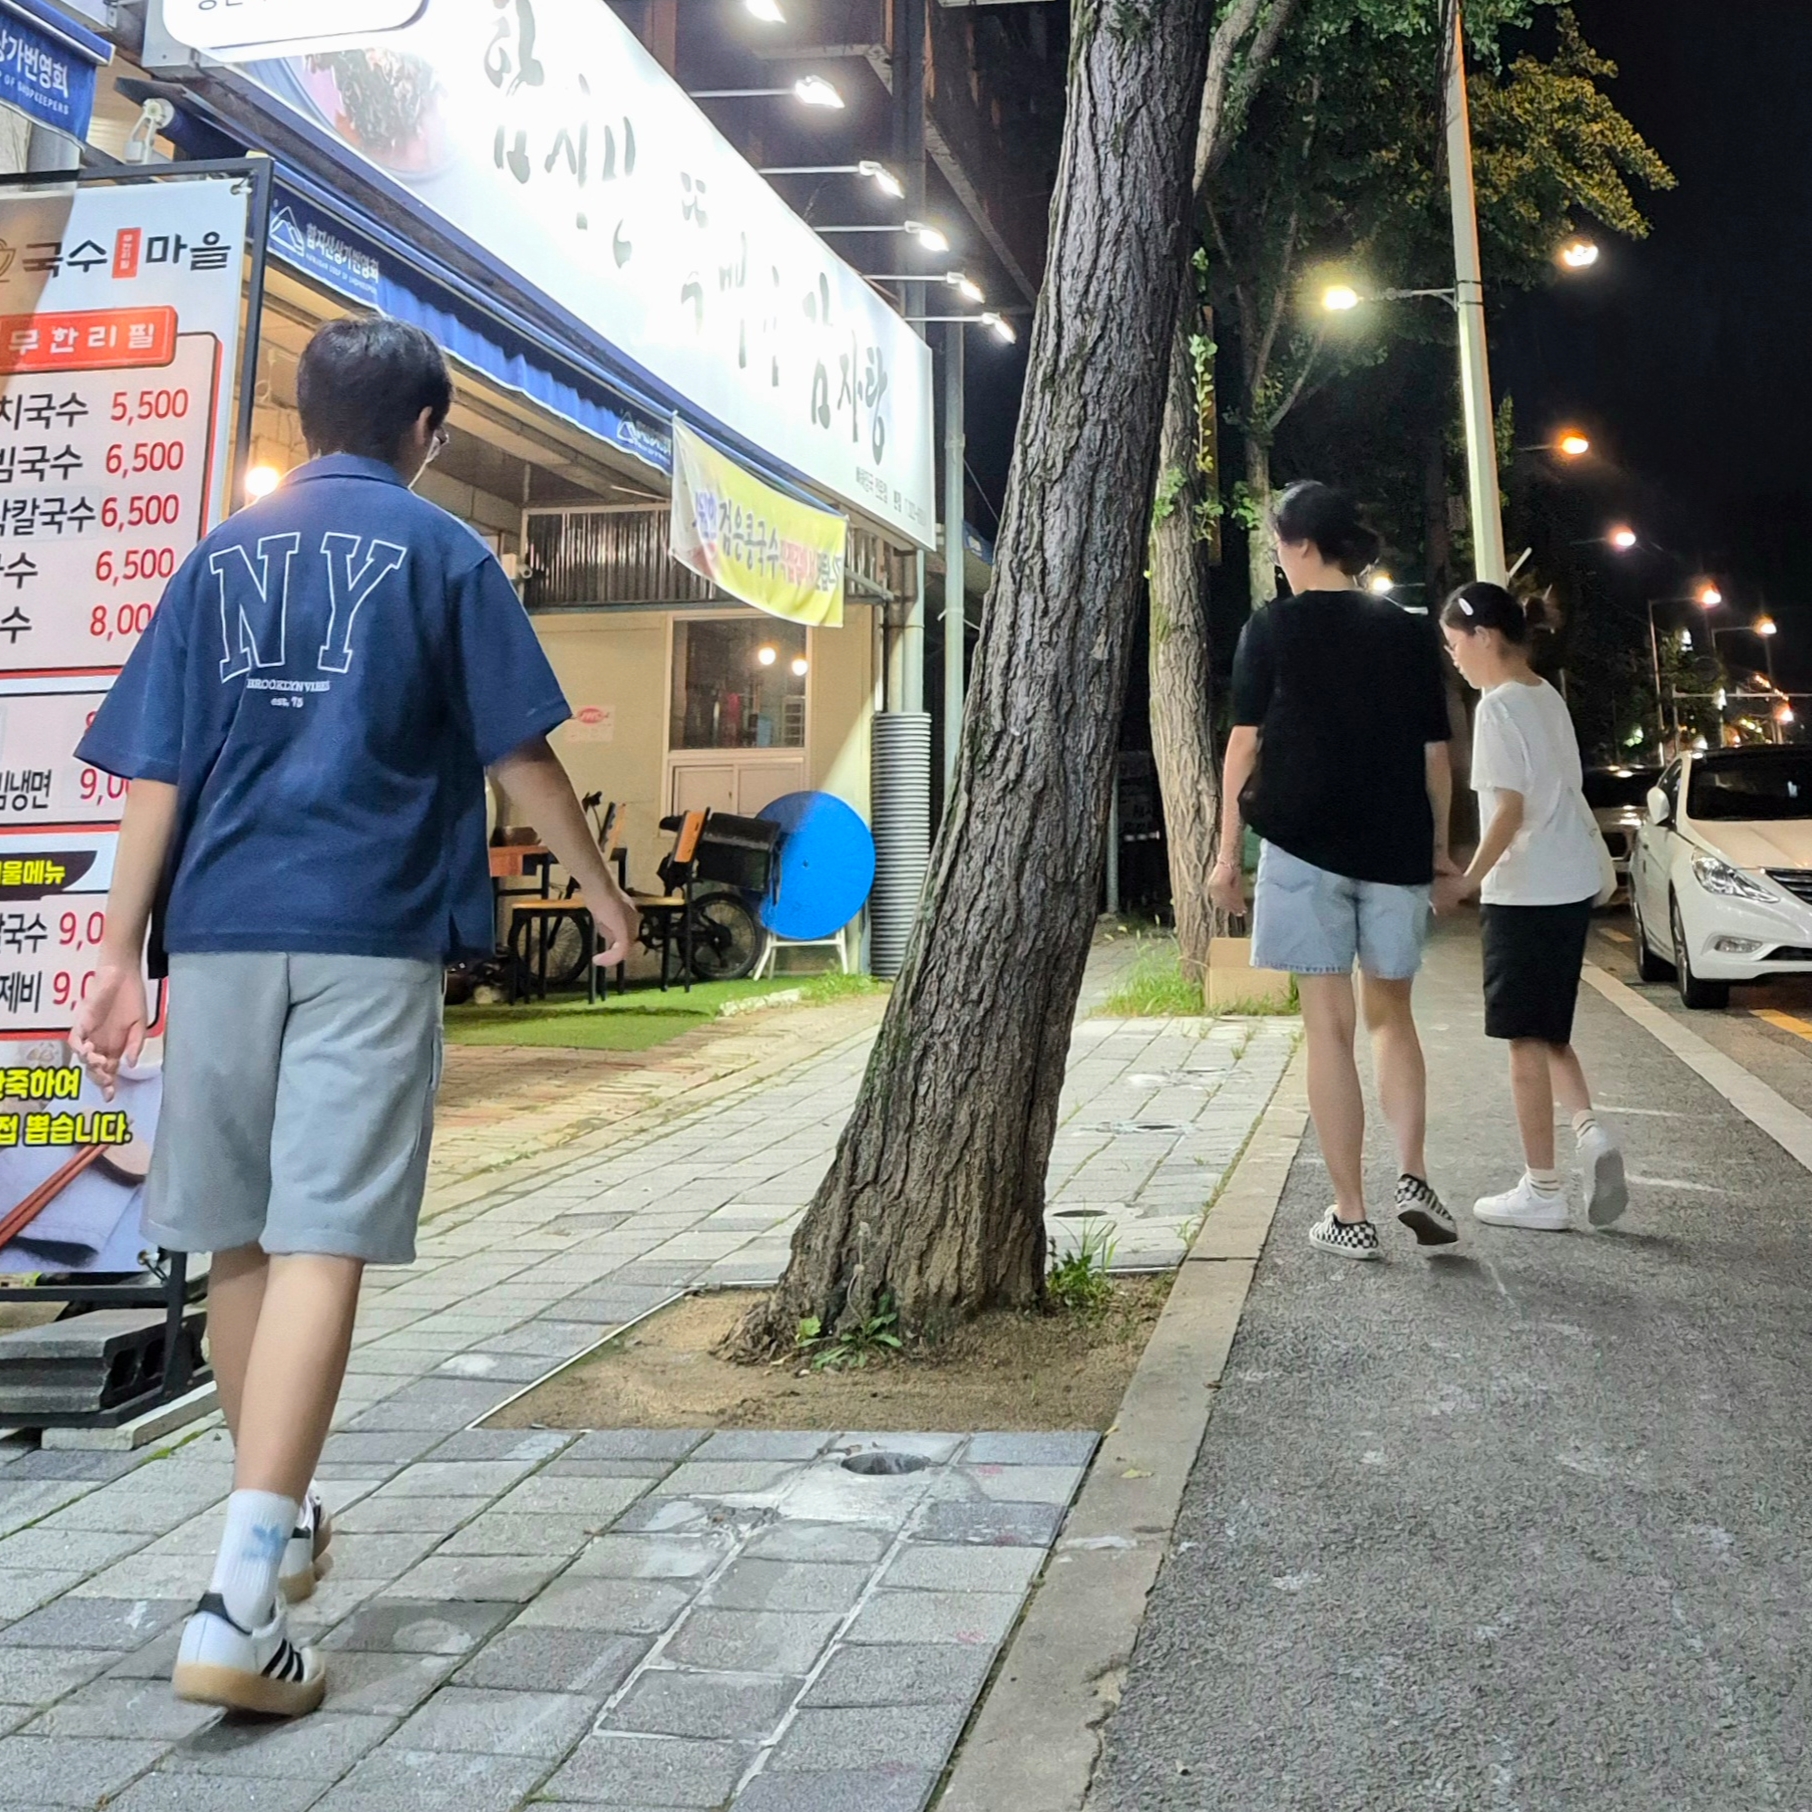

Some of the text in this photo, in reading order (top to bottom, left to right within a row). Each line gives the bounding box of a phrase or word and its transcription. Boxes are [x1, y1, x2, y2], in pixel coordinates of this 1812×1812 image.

[22, 231, 232, 278] 국수 마을
[111, 388, 189, 425] 5,500
[105, 441, 184, 479] 6,500
[101, 494, 180, 532] 6,500
[95, 548, 175, 587] 6,500
[209, 531, 407, 684] NY
[0, 912, 48, 954] 국수
[0, 1067, 80, 1100] 죽하여
[24, 1112, 132, 1145] 뽑습니다.
